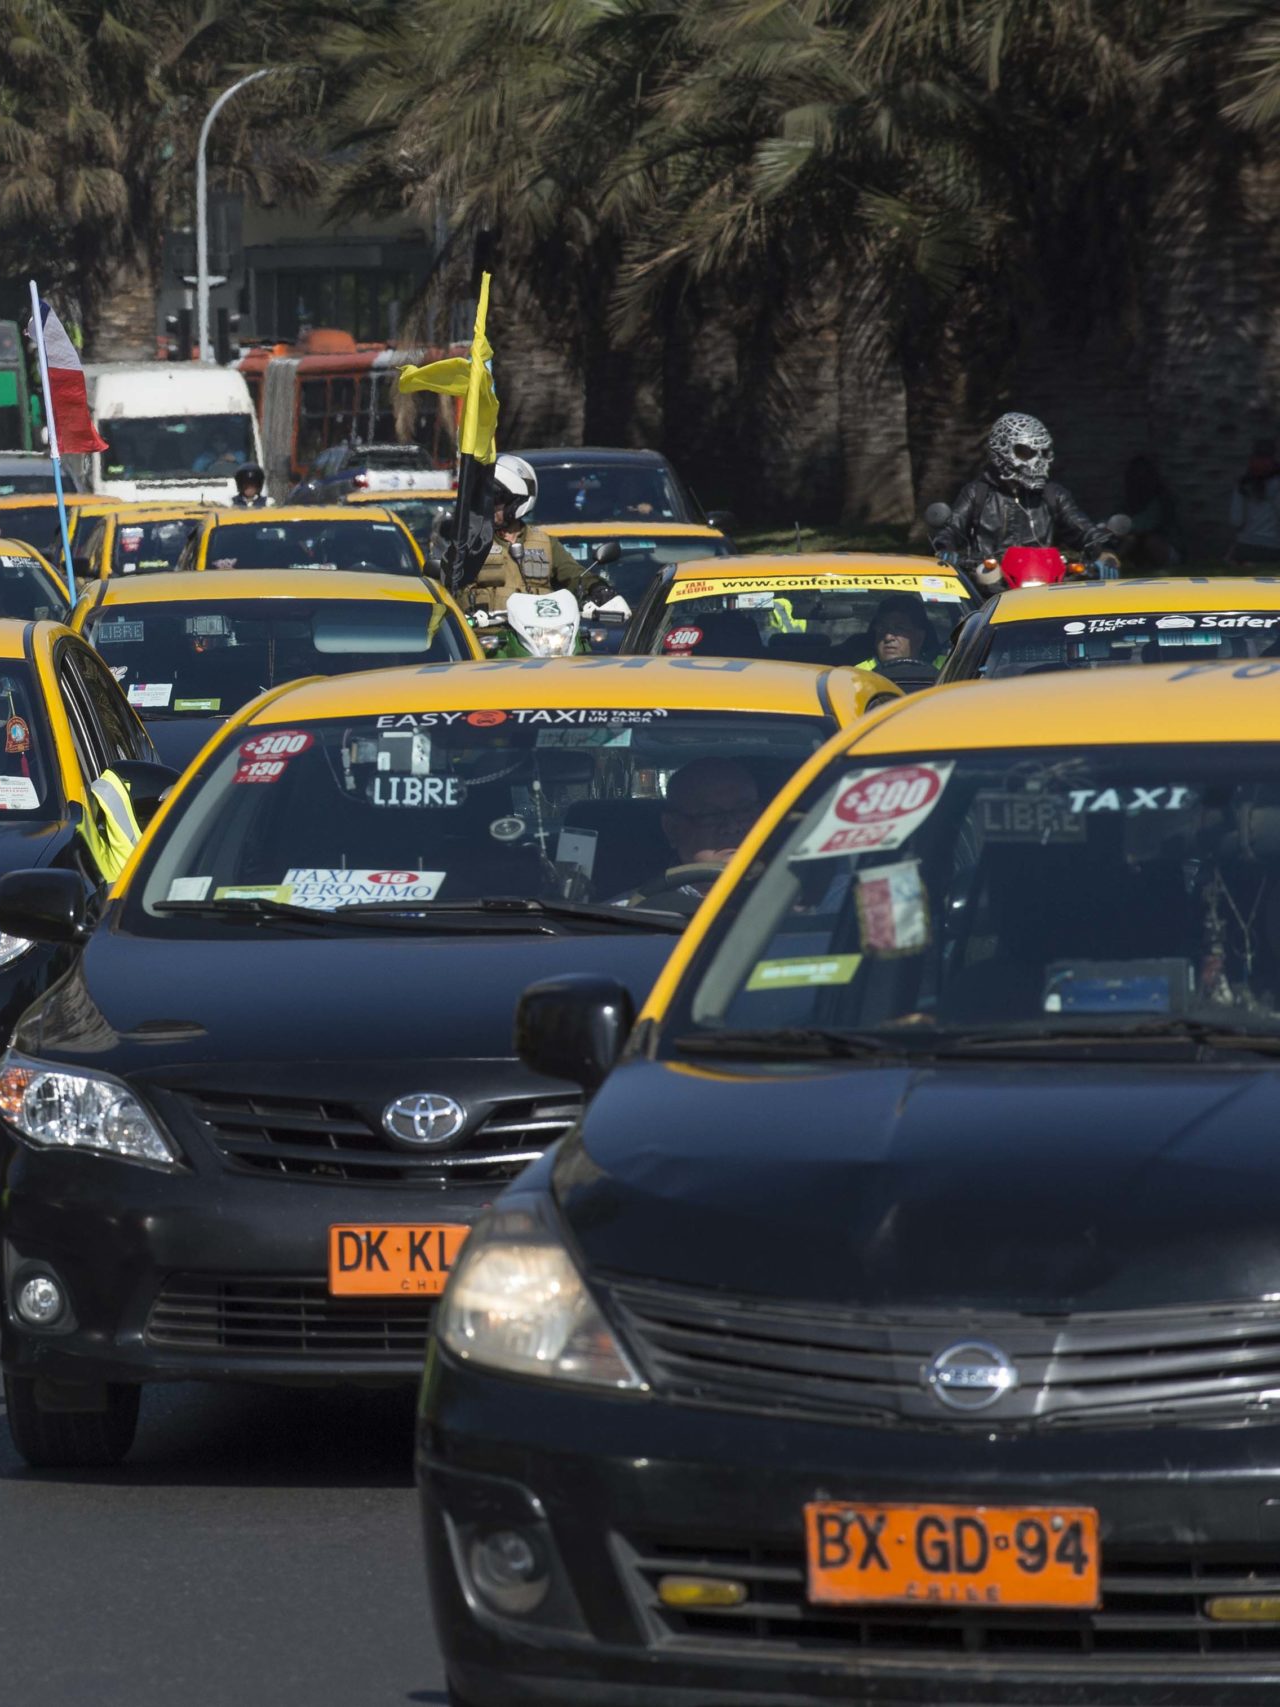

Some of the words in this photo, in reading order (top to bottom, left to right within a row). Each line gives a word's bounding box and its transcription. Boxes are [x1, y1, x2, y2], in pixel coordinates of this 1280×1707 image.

[722, 576, 918, 588] www.confenatach.cl
[675, 586, 715, 597] SEGURO
[1087, 617, 1147, 629] Ticket
[1200, 616, 1280, 628] Safer
[100, 624, 144, 640] LIBRE
[376, 712, 463, 728] EASY
[512, 709, 585, 724] TAXI
[245, 734, 308, 755] $300
[240, 761, 285, 776] $130
[373, 776, 459, 807] LIBRE
[843, 776, 933, 815] $300
[1069, 787, 1189, 813] TAXI
[983, 801, 1081, 832] LIBRE
[290, 869, 354, 883] TAXI
[377, 871, 410, 884] 16
[904, 1582, 1001, 1601] CHILE
